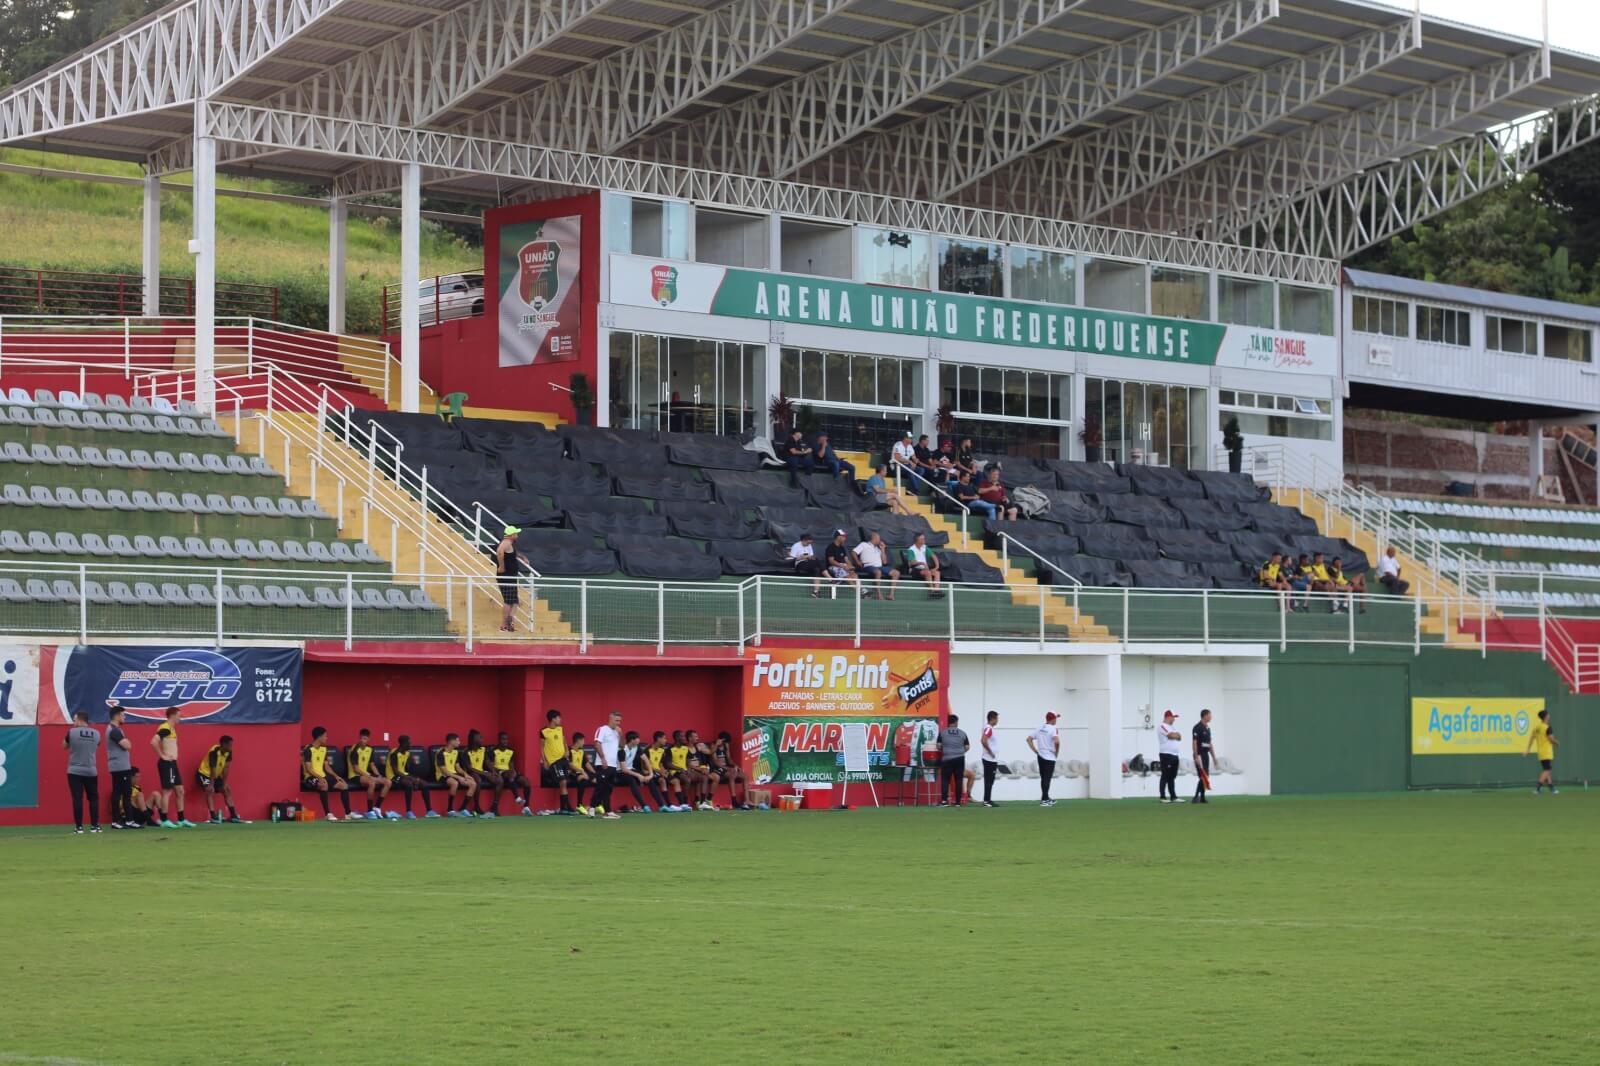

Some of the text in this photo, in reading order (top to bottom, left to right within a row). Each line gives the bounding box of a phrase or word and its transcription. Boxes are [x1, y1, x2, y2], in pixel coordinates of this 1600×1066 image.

[525, 249, 555, 263] UNIÃO
[755, 281, 1189, 358] ARENA UNIÃO FREDERIQUENSE
[1261, 335, 1273, 353] NO
[1274, 336, 1306, 357] SANGUE
[752, 654, 890, 689] Fortis Print
[109, 679, 242, 700] BETO
[265, 677, 291, 688] 3744
[904, 676, 933, 702] Fortis
[255, 689, 293, 702] 6172
[780, 692, 815, 701] FACHADAS
[820, 692, 844, 701] LETRAS
[768, 702, 875, 712] ADESIVOS BANNERS OUTDOORS
[1428, 705, 1513, 742] Agafarma
[779, 723, 890, 752] MARN
[786, 772, 834, 781] A LOJA OFICIAL
